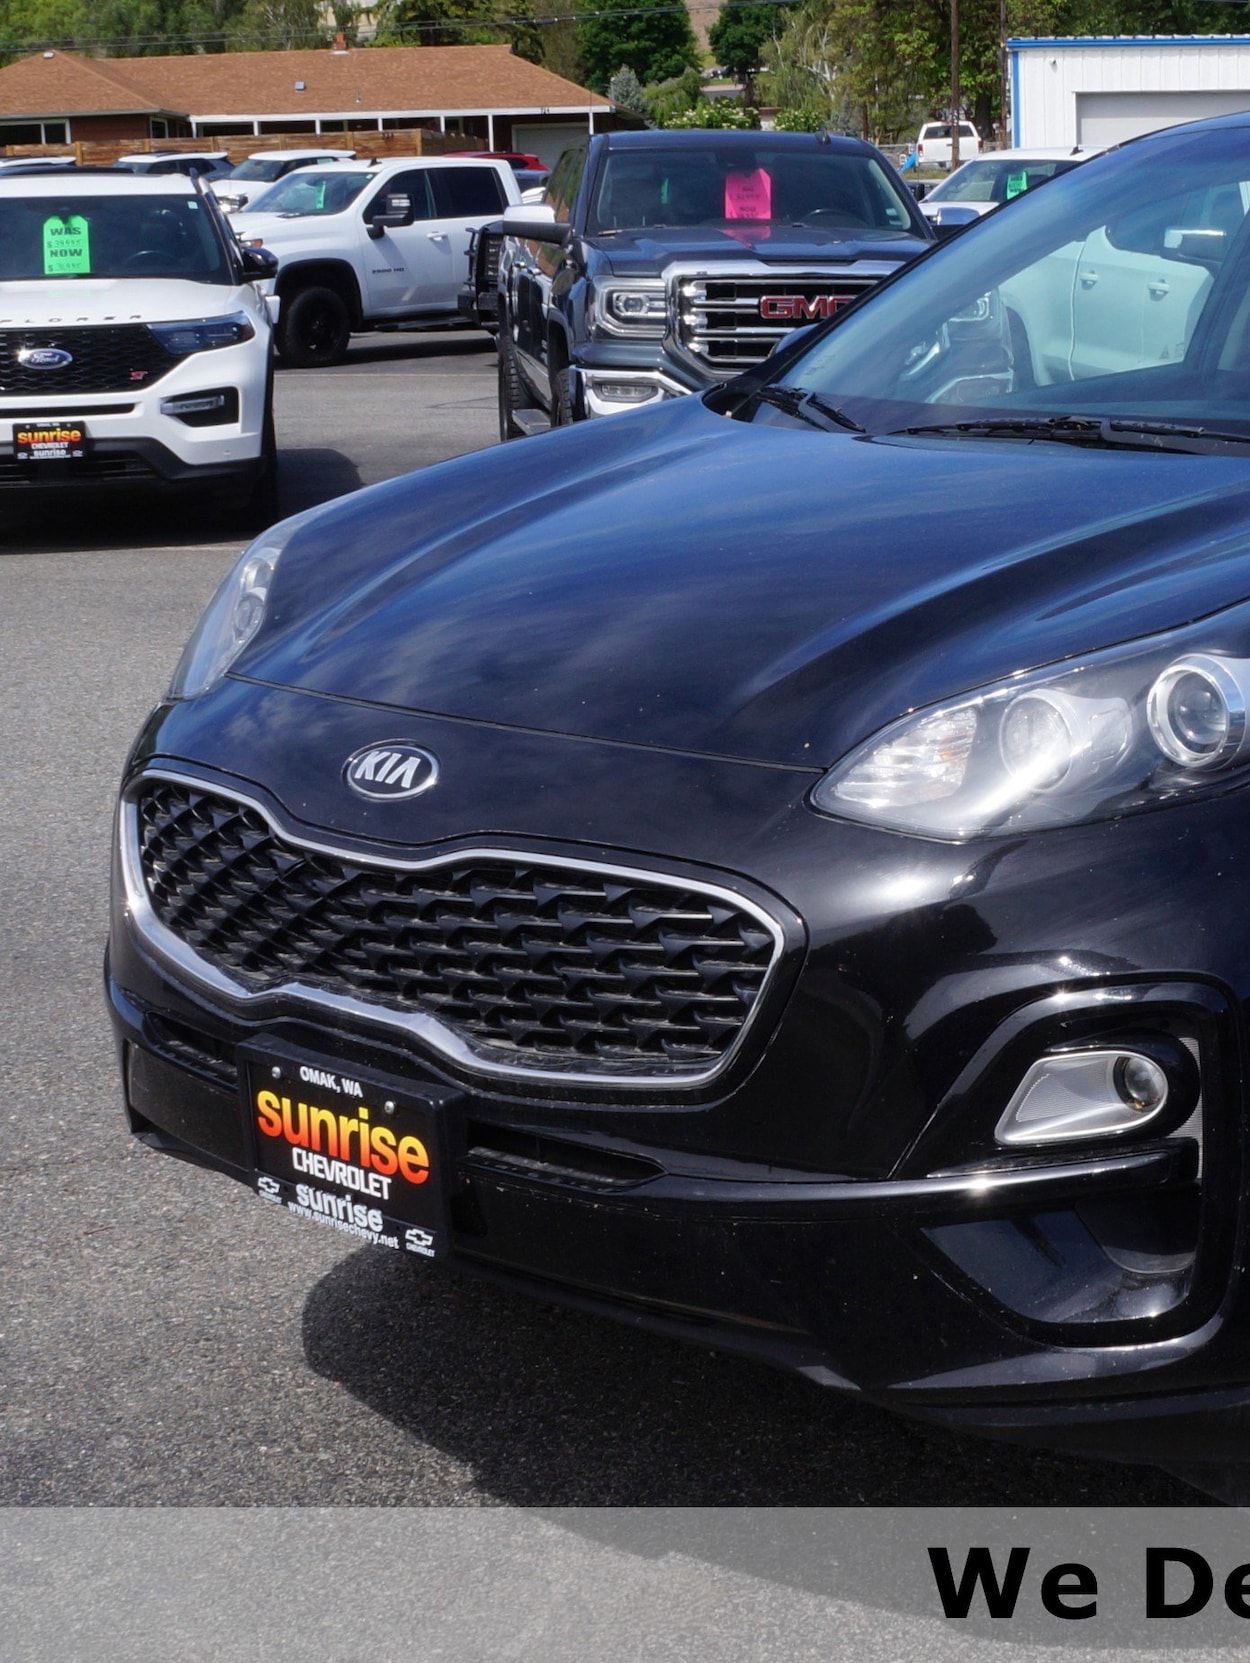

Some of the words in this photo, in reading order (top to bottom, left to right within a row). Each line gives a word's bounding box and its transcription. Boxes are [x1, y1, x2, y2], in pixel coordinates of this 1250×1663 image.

[50, 227, 81, 236] WAS
[49, 248, 83, 258] NOW
[31, 352, 60, 365] Ford
[17, 428, 81, 444] sunrise
[354, 751, 421, 789] KIA
[299, 1065, 342, 1094] OMAK,
[341, 1077, 363, 1098] WA
[256, 1090, 430, 1184] sunrise
[292, 1147, 392, 1200] CHEVROLET
[296, 1183, 383, 1232] sunrise
[287, 1201, 400, 1250] www.sunrisechevy.net
